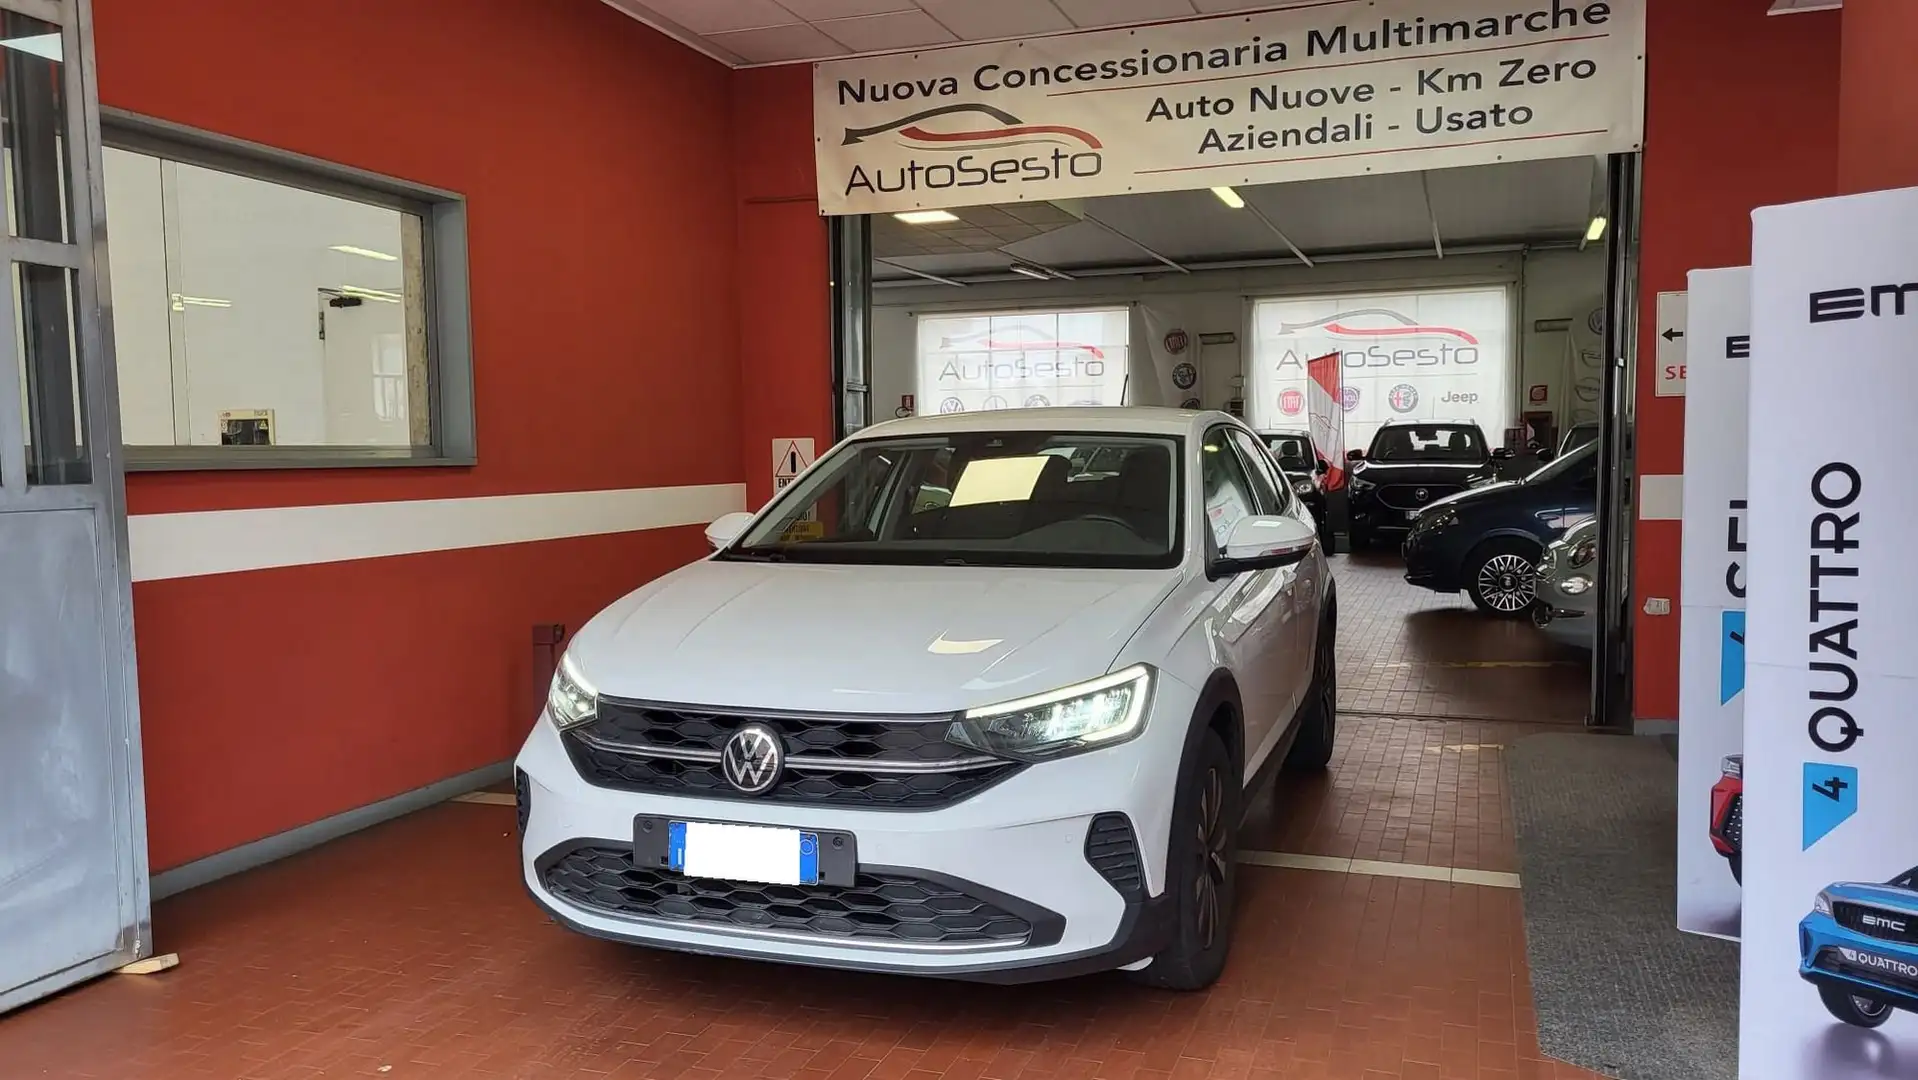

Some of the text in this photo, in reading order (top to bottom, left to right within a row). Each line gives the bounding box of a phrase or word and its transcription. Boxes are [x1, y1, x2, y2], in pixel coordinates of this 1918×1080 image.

[838, 0, 1611, 105] Nuova Concessionaria Multimarche
[1145, 94, 1234, 123] Auto
[1249, 82, 1374, 112] Nuove
[1417, 67, 1482, 96] Km
[1499, 58, 1597, 87] Zero
[1197, 113, 1373, 154] Aziendali
[1416, 103, 1533, 134] Usato
[845, 148, 1103, 196] AutoSesto
[1809, 283, 1918, 323] EM
[938, 355, 1104, 383] AutoSesto
[1441, 391, 1478, 404] Jeep
[1808, 461, 1864, 802] 4 QUATTRO
[1862, 914, 1906, 932] EMC
[1858, 952, 1918, 977] QUATTRO
